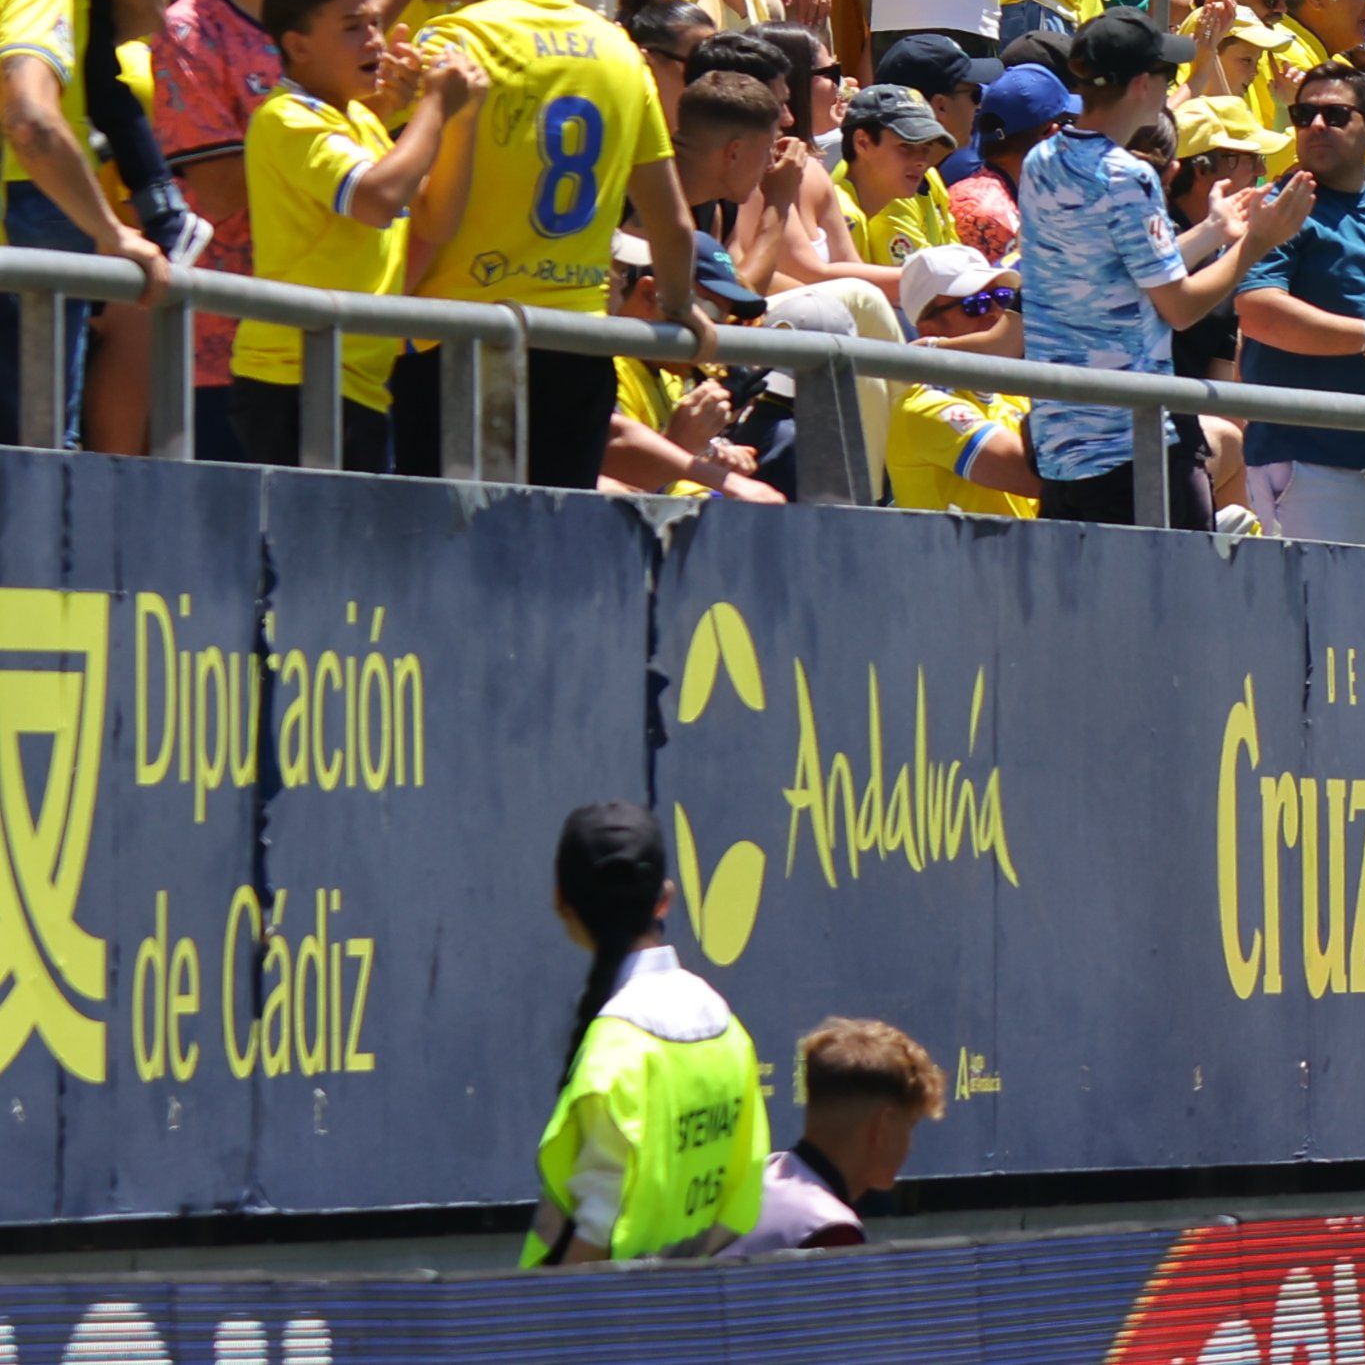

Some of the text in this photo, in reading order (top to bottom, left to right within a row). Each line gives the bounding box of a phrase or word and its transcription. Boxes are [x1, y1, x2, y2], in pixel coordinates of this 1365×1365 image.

[533, 31, 599, 59] ALEX
[529, 95, 605, 239] 8
[136, 592, 424, 823] Dipuación
[133, 884, 376, 1082] de Cádiz
